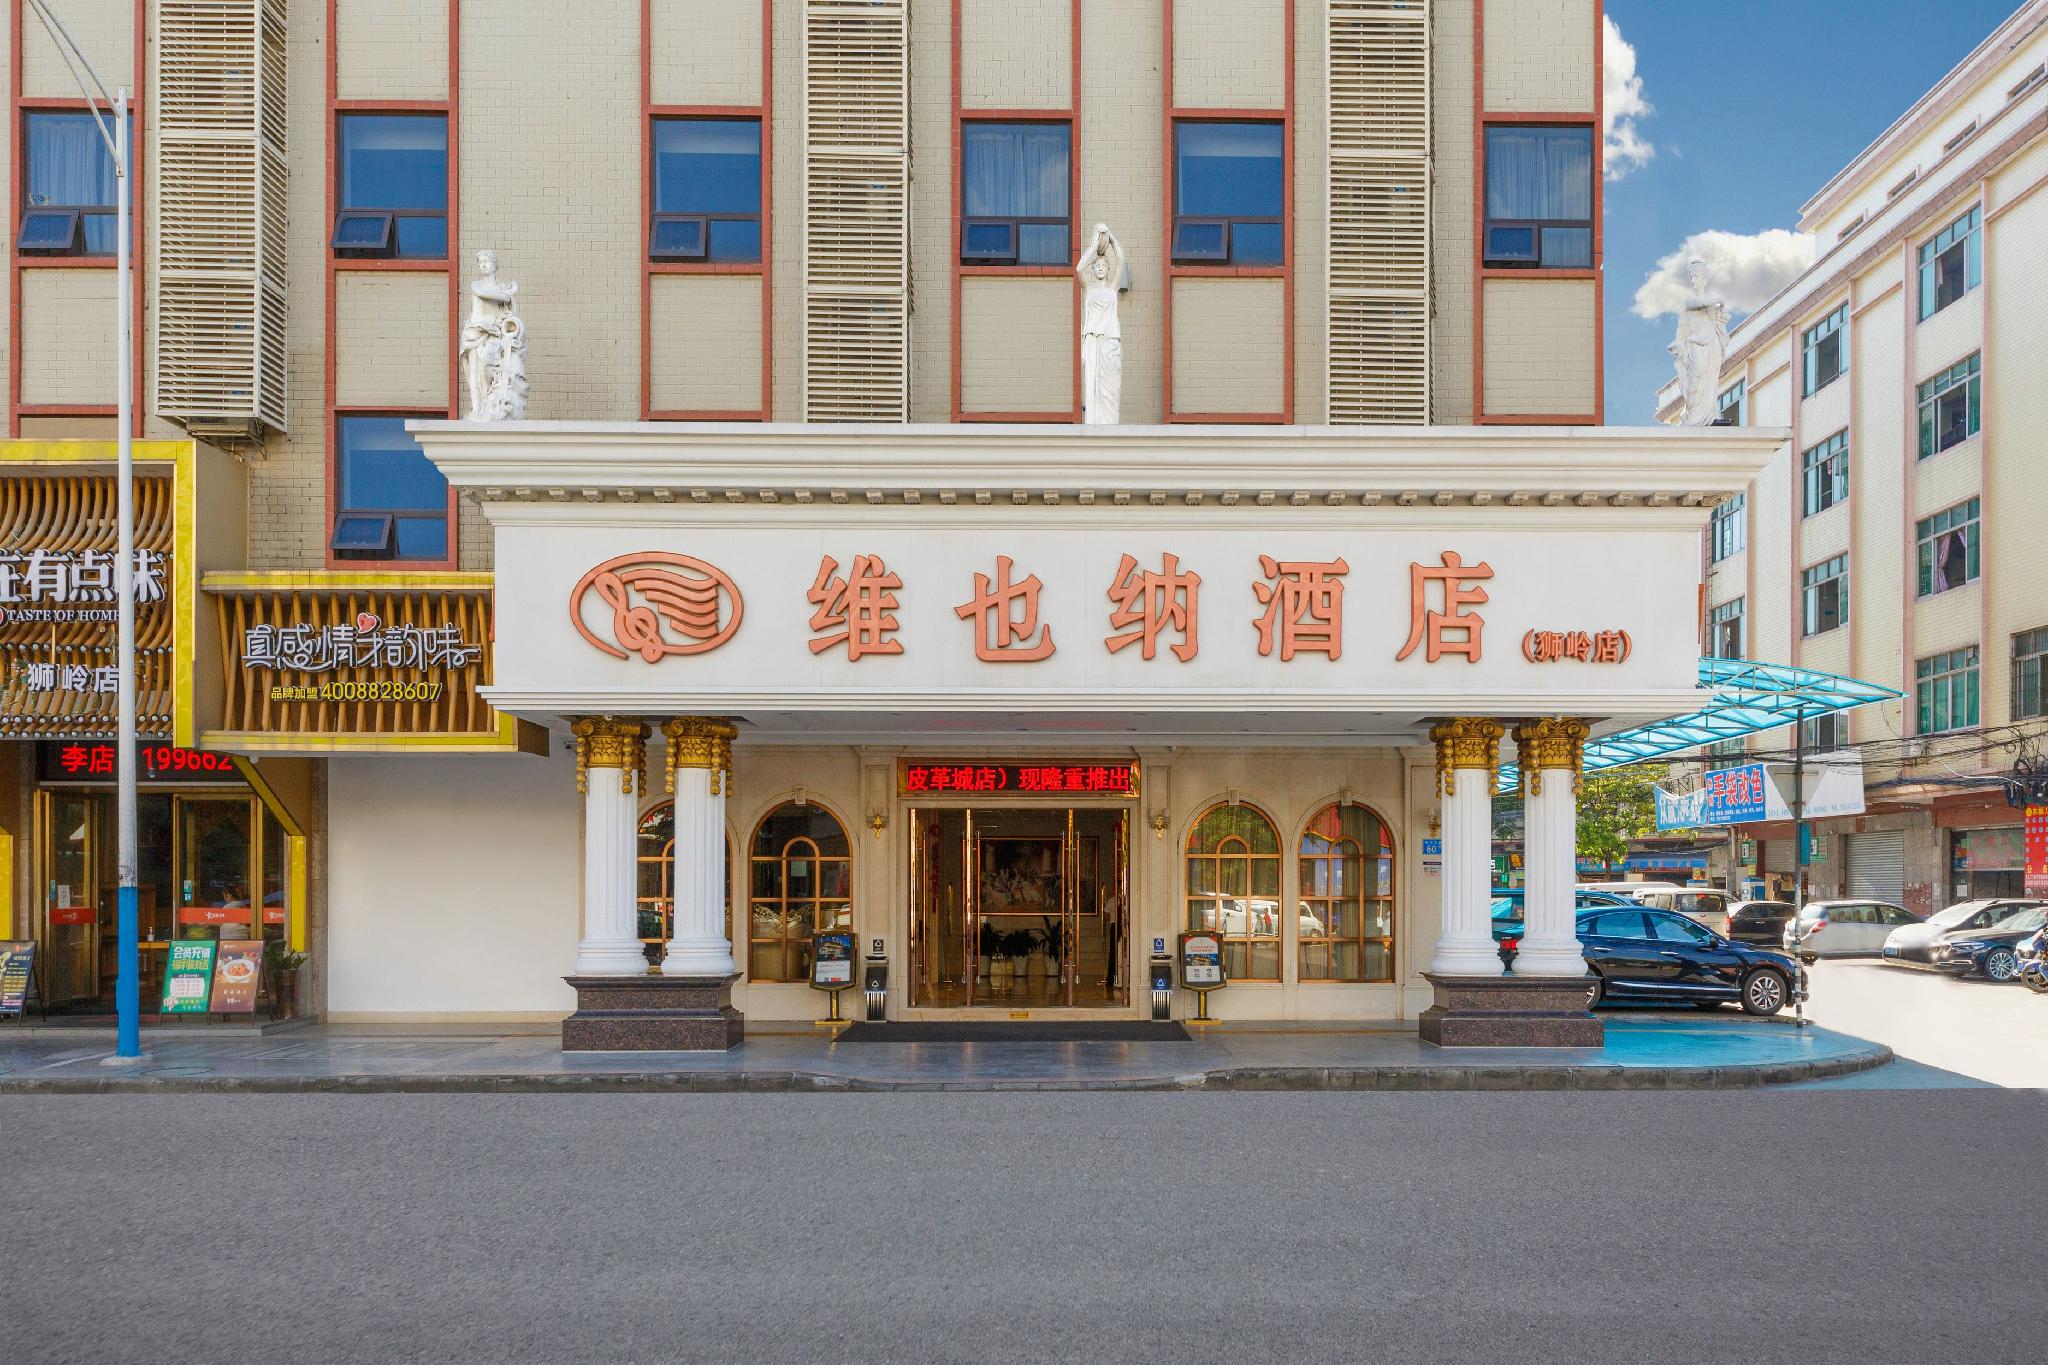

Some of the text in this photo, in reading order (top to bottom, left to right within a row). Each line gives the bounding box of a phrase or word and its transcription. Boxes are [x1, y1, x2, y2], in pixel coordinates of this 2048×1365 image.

[8, 610, 50, 621] TASTE
[55, 610, 75, 621] OF
[807, 550, 1494, 662] 维也纳酒店
[1522, 628, 1633, 665] (狮岭店)
[28, 664, 119, 693] 狮岭店
[271, 682, 442, 700] 品牌加盟 4008828607
[1712, 767, 1764, 808] 手袋改色
